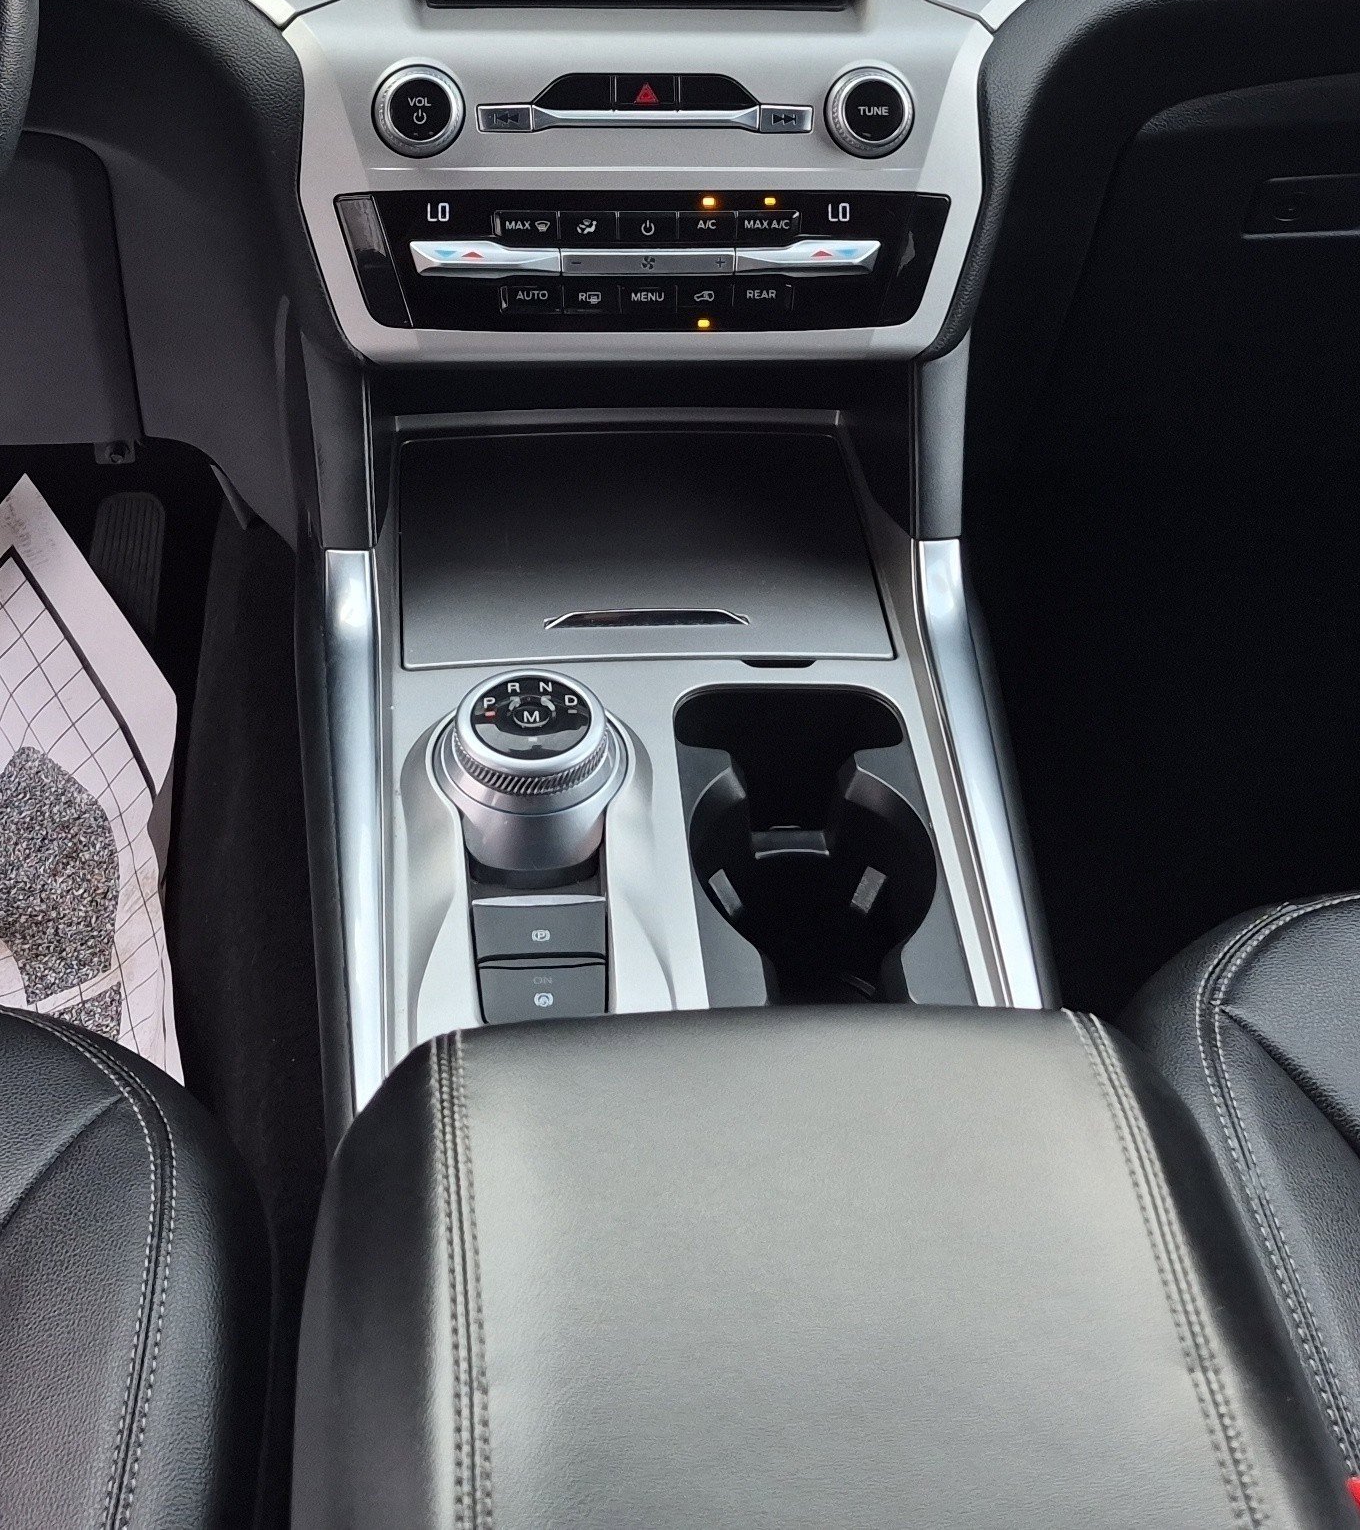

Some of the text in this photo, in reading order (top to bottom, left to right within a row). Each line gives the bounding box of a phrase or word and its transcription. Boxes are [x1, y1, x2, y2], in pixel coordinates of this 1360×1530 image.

[408, 97, 432, 107] VOL
[857, 106, 890, 116] TUNE
[427, 202, 450, 222] LO
[828, 202, 850, 222] LO
[505, 221, 531, 230] MAX
[697, 220, 717, 230] A/C
[744, 220, 790, 230] MAX A/C
[516, 290, 549, 301] AUTO
[631, 292, 665, 302] MENU
[746, 290, 777, 300] REAR
[507, 681, 553, 693] R N
[483, 695, 578, 709] P D
[523, 710, 540, 723] M
[533, 976, 553, 985] ON
